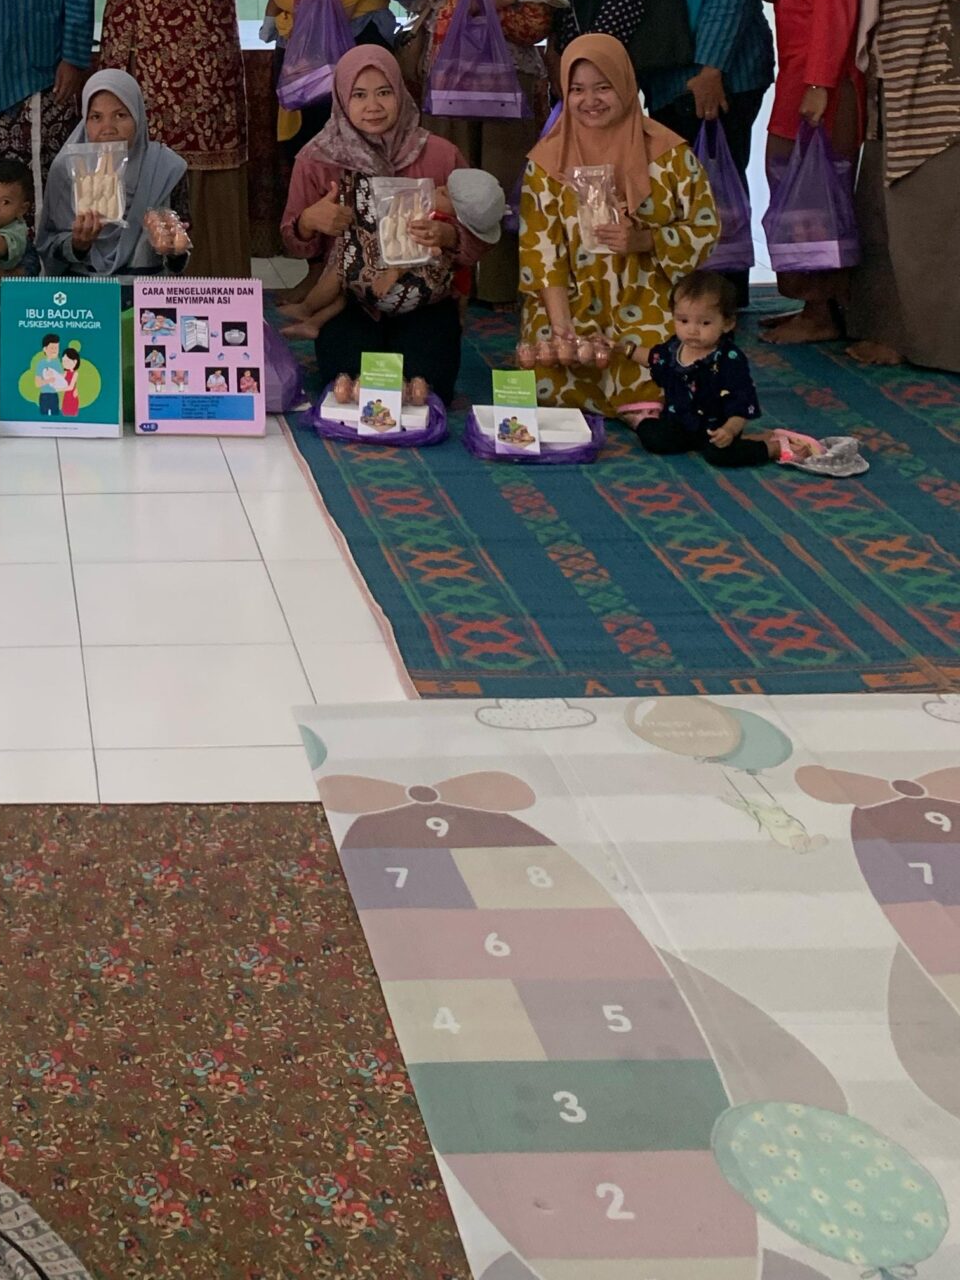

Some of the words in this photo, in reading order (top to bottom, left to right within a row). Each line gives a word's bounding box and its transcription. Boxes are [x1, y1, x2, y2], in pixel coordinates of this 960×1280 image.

[142, 287, 165, 295] CARA
[166, 287, 235, 296] MENGELUARKAN
[237, 287, 254, 296] DAN
[166, 296, 215, 305] MENYIMPAN
[217, 296, 231, 305] ASI
[18, 320, 64, 329] PUSKESMAS
[65, 321, 102, 329] MINGGIR
[25, 308, 45, 319] IBU
[47, 308, 94, 320] BADUTA
[426, 817, 449, 837] 9
[925, 812, 952, 832] 9
[385, 867, 409, 888] 7
[526, 865, 553, 888] 8
[907, 862, 934, 885] 7
[484, 933, 511, 957] 6
[433, 1006, 461, 1034] 4
[602, 1004, 633, 1033] 5
[553, 1091, 587, 1123] 3
[596, 1183, 635, 1219] 2
